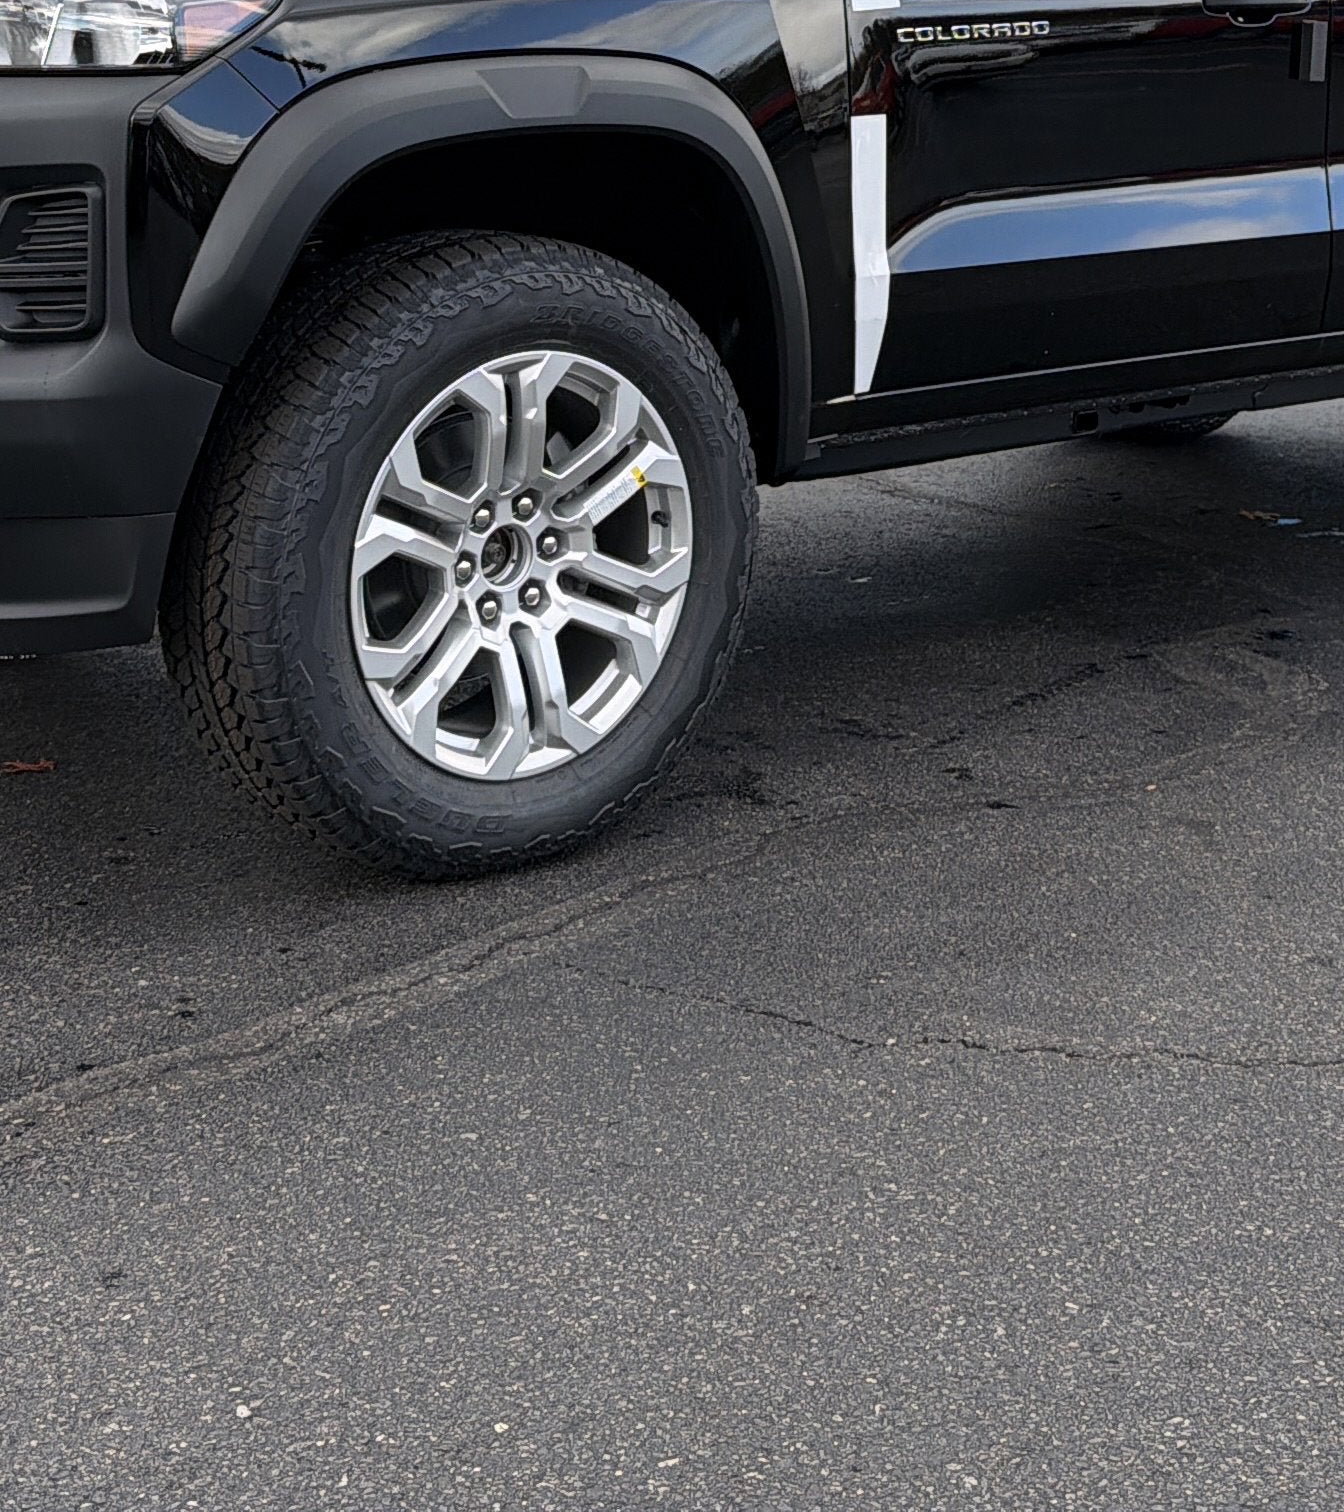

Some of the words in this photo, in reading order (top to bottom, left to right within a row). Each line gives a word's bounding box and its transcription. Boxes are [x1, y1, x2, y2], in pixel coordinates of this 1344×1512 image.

[896, 20, 1050, 43] COLORADO
[529, 302, 727, 459] BRIDGESTONE
[340, 720, 512, 834] DUELER
